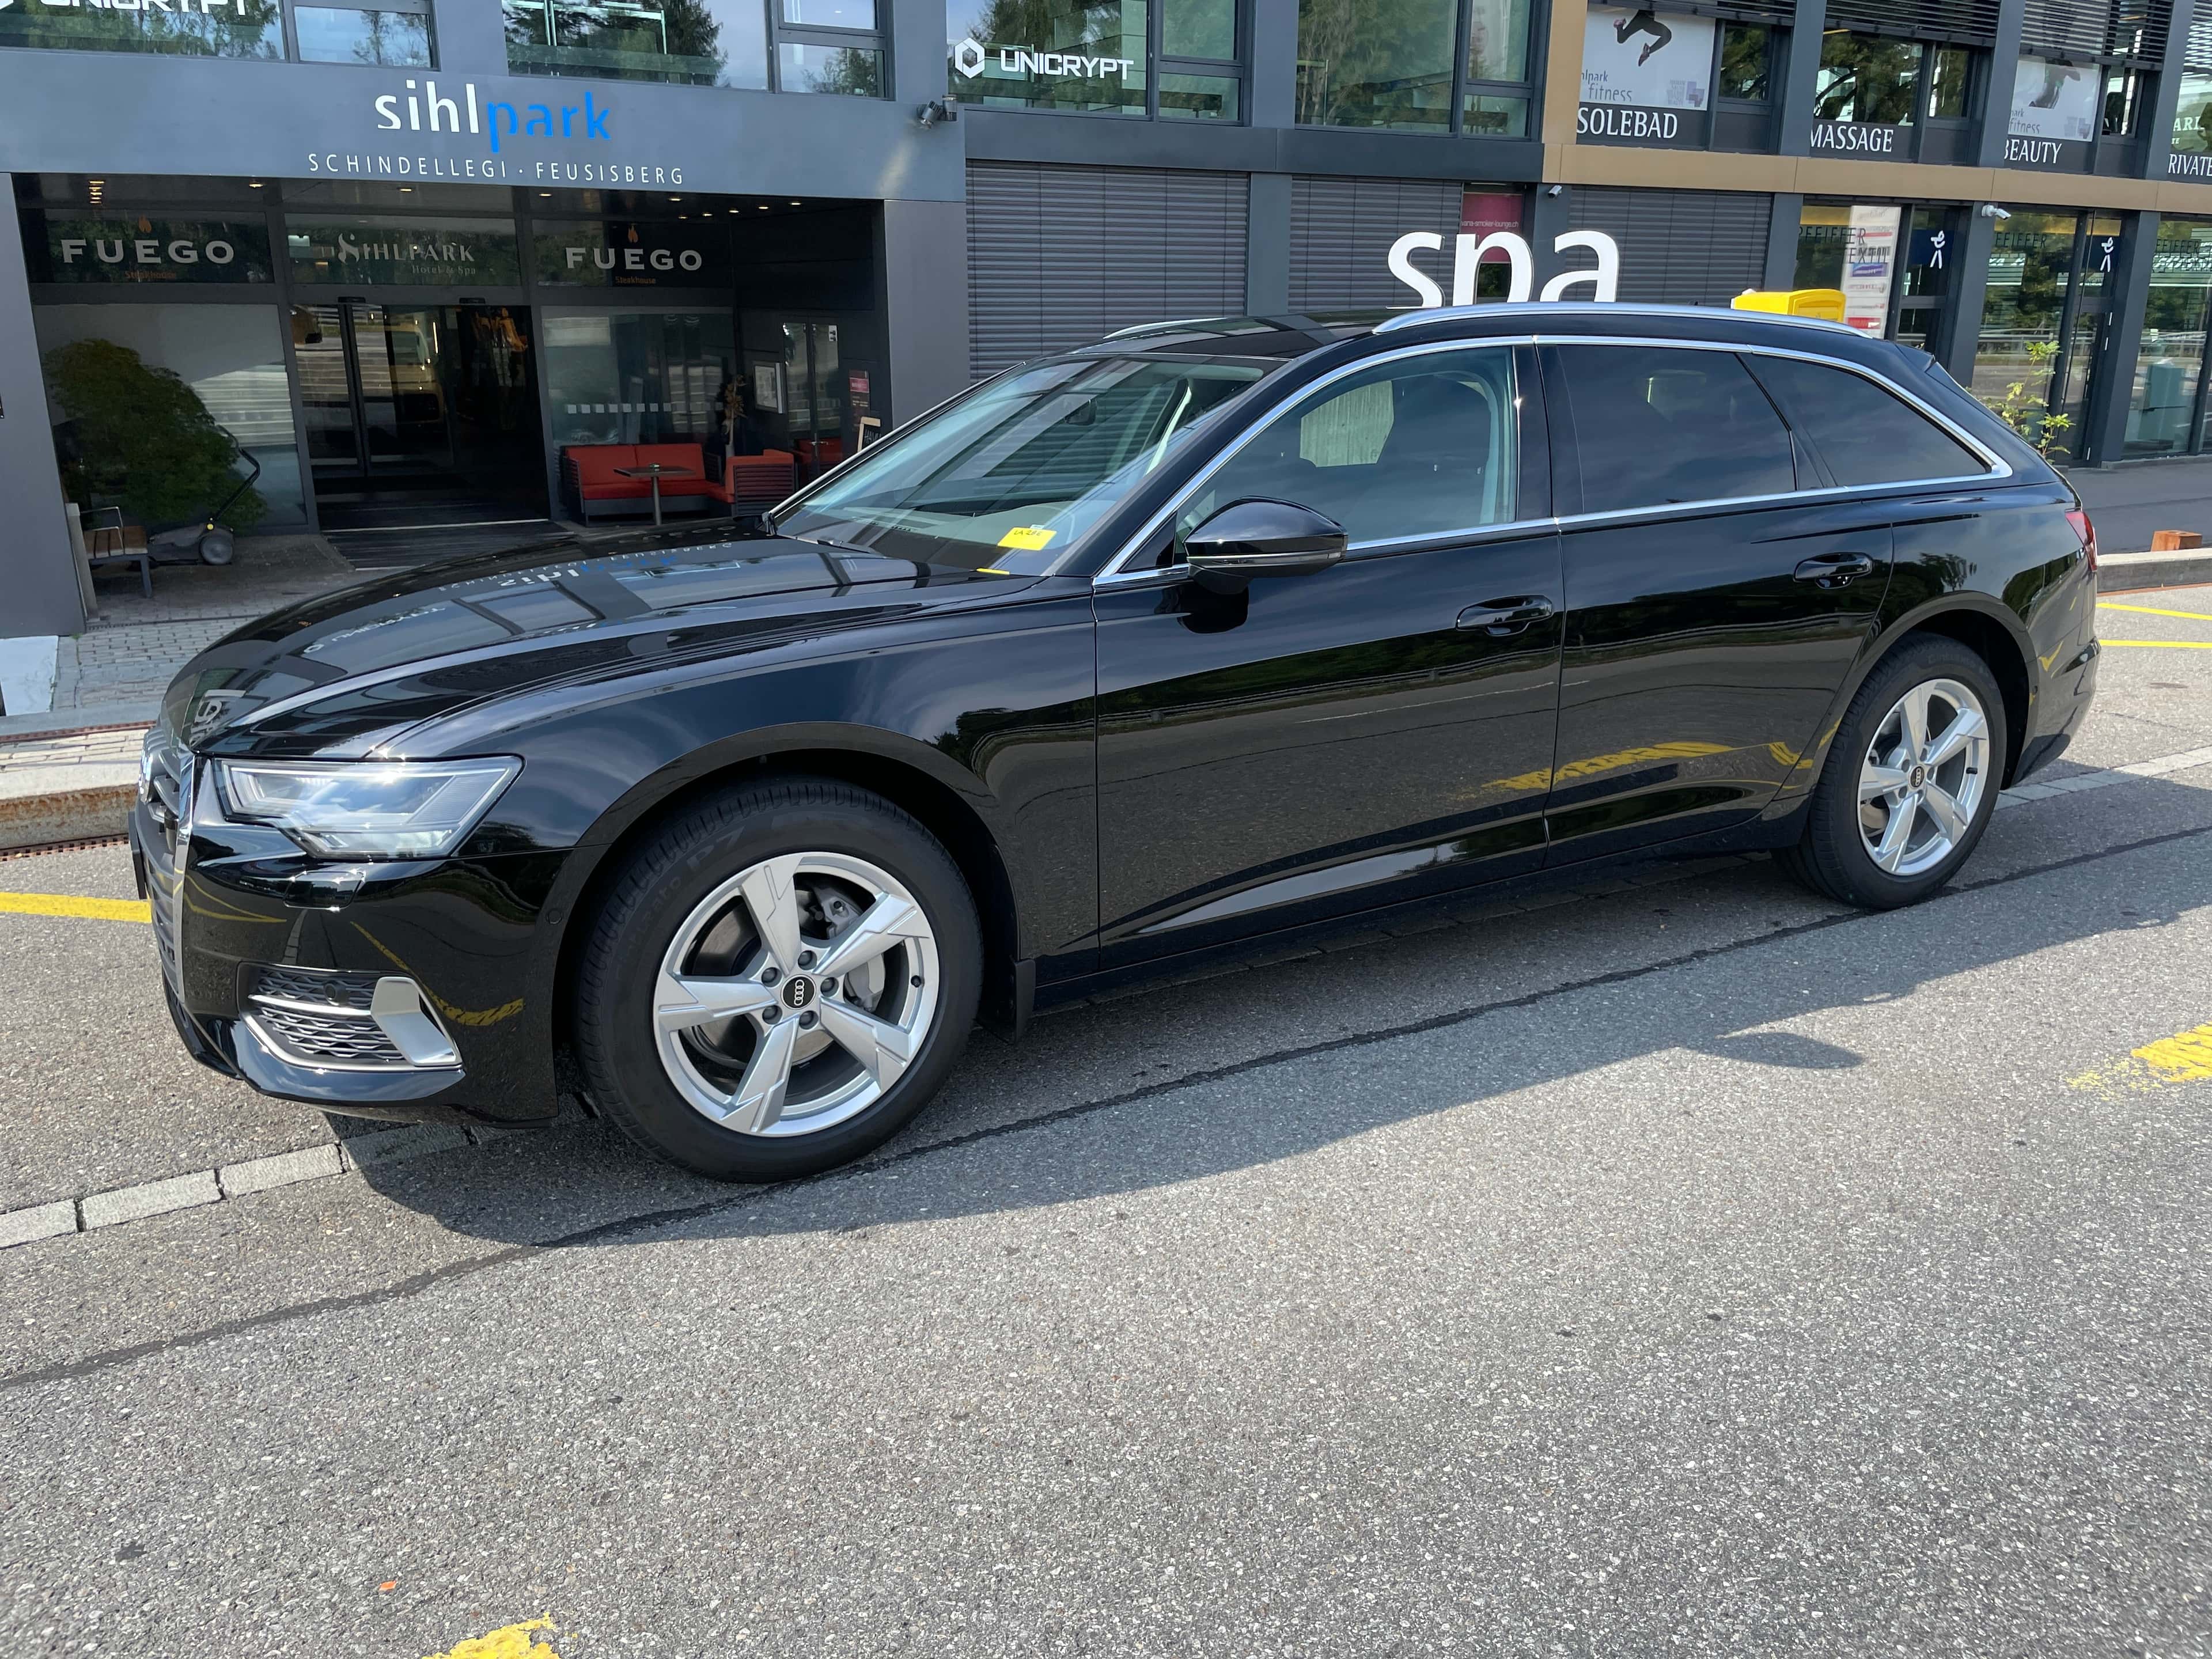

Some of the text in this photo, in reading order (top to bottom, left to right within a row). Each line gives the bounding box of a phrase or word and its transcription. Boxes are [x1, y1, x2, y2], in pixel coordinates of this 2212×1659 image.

[1000, 50, 1134, 80] UNICRYPT
[1588, 83, 1633, 102] fitness
[374, 79, 611, 153] sihlpark
[1576, 107, 1677, 138] SOLEBAD
[2010, 118, 2040, 134] fitness
[309, 153, 683, 185] SCHINDELLEGI FEUSISBERG
[60, 239, 234, 264] FUEGO
[565, 247, 702, 271] FUEGO
